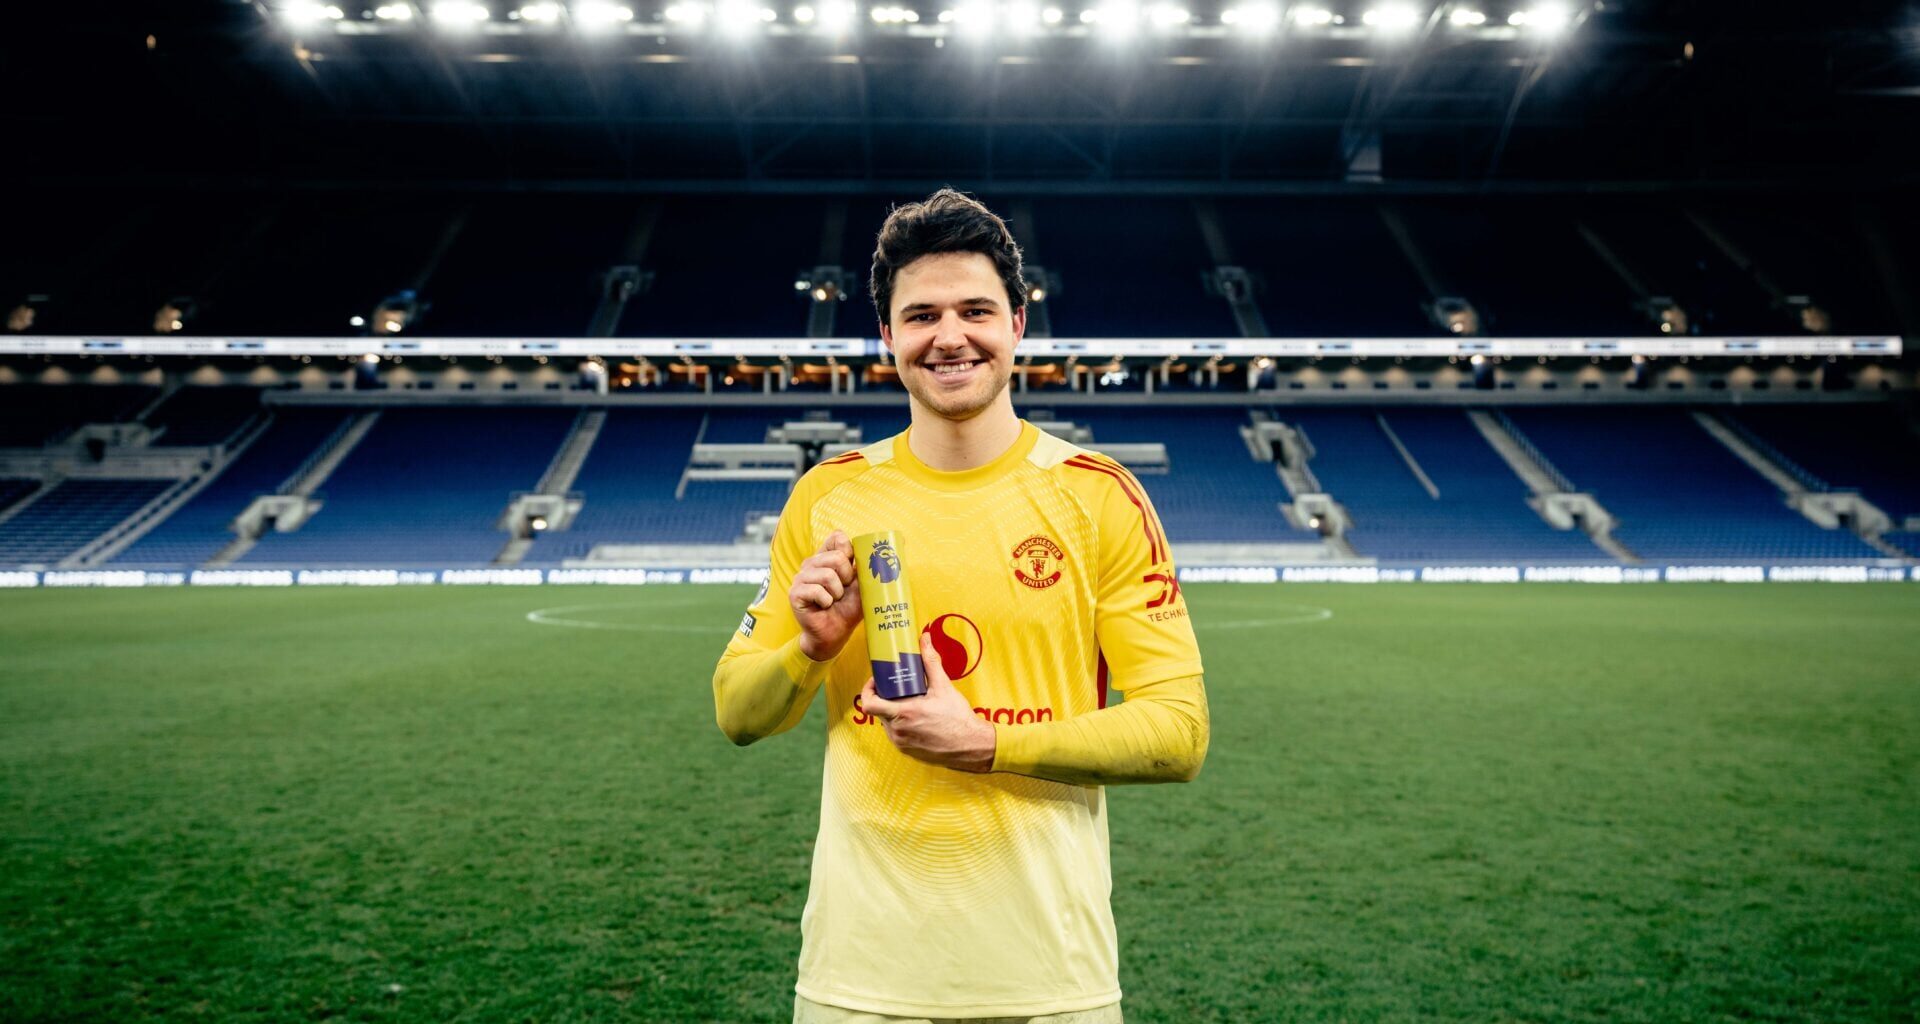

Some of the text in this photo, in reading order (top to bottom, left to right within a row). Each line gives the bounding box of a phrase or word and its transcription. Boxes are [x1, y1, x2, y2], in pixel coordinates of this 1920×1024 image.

[1015, 538, 1061, 558] MANCHESTER
[1022, 576, 1054, 587] UNITED
[1143, 569, 1181, 609] DX
[874, 602, 909, 614] PLAYER
[878, 619, 910, 631] MATCH
